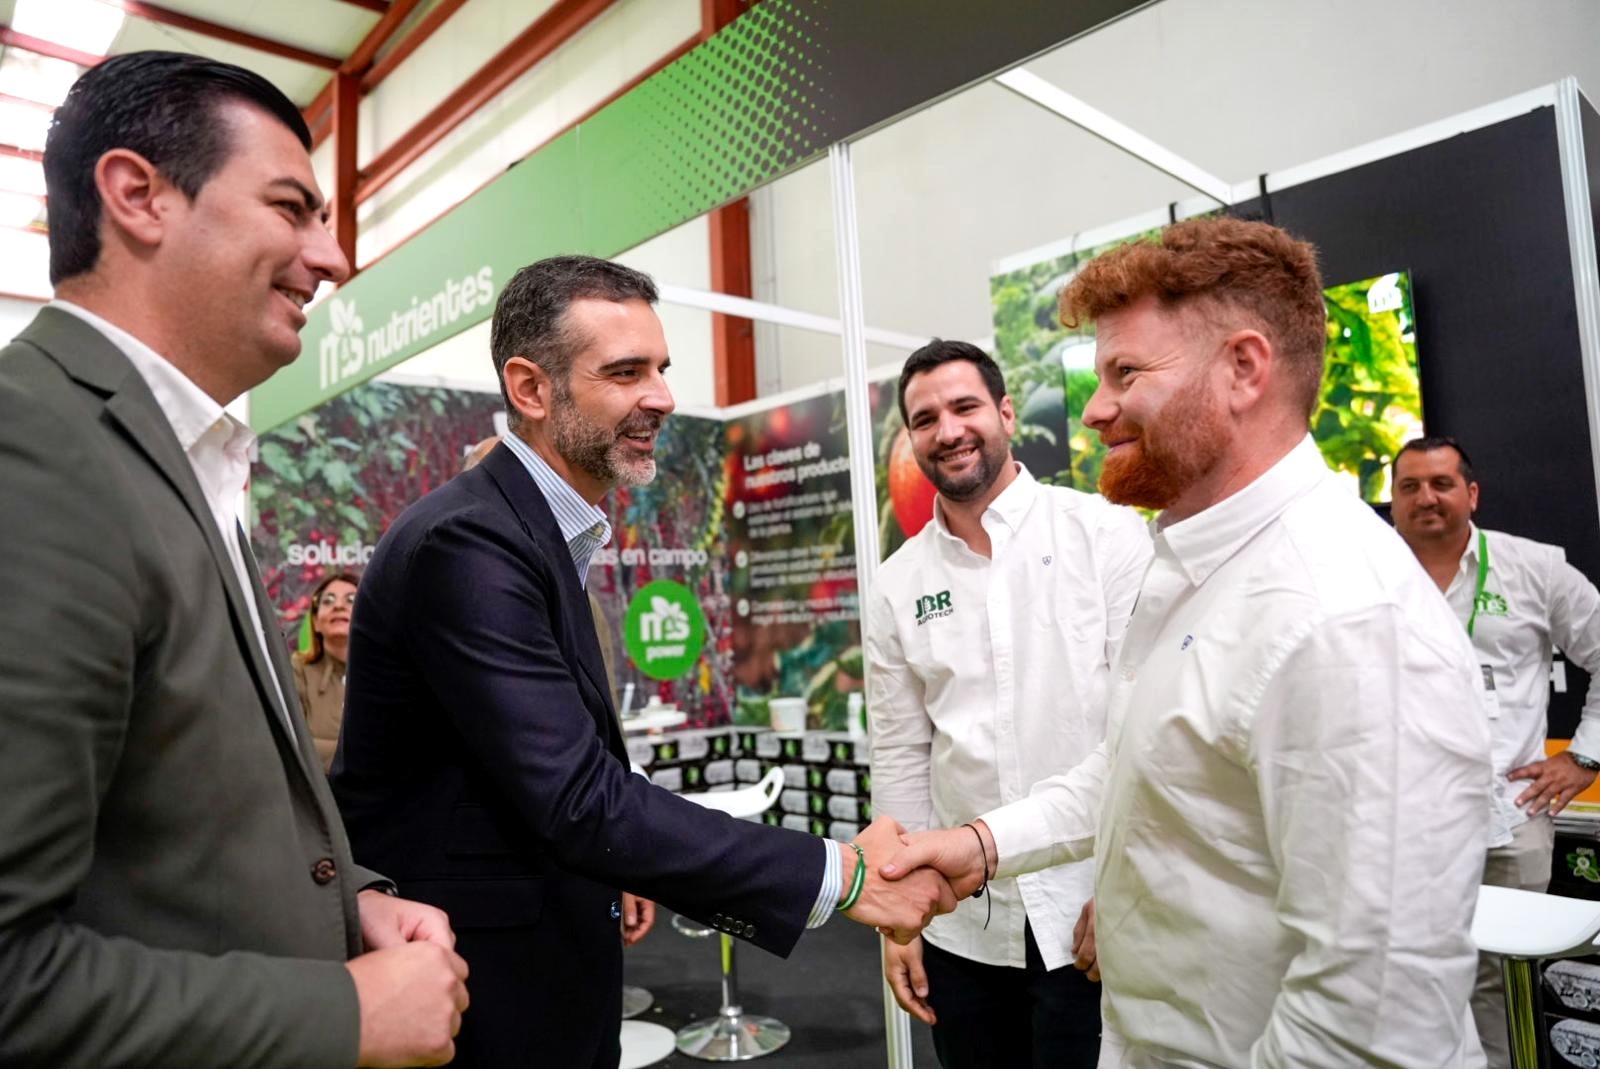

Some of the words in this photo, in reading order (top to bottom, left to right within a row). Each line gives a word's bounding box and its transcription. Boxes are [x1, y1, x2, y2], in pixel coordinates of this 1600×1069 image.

[367, 265, 493, 363] nutrientes
[803, 440, 821, 458] de
[797, 456, 850, 483] producto
[621, 548, 647, 566] en
[648, 548, 708, 571] campo
[914, 590, 952, 619] JBR
